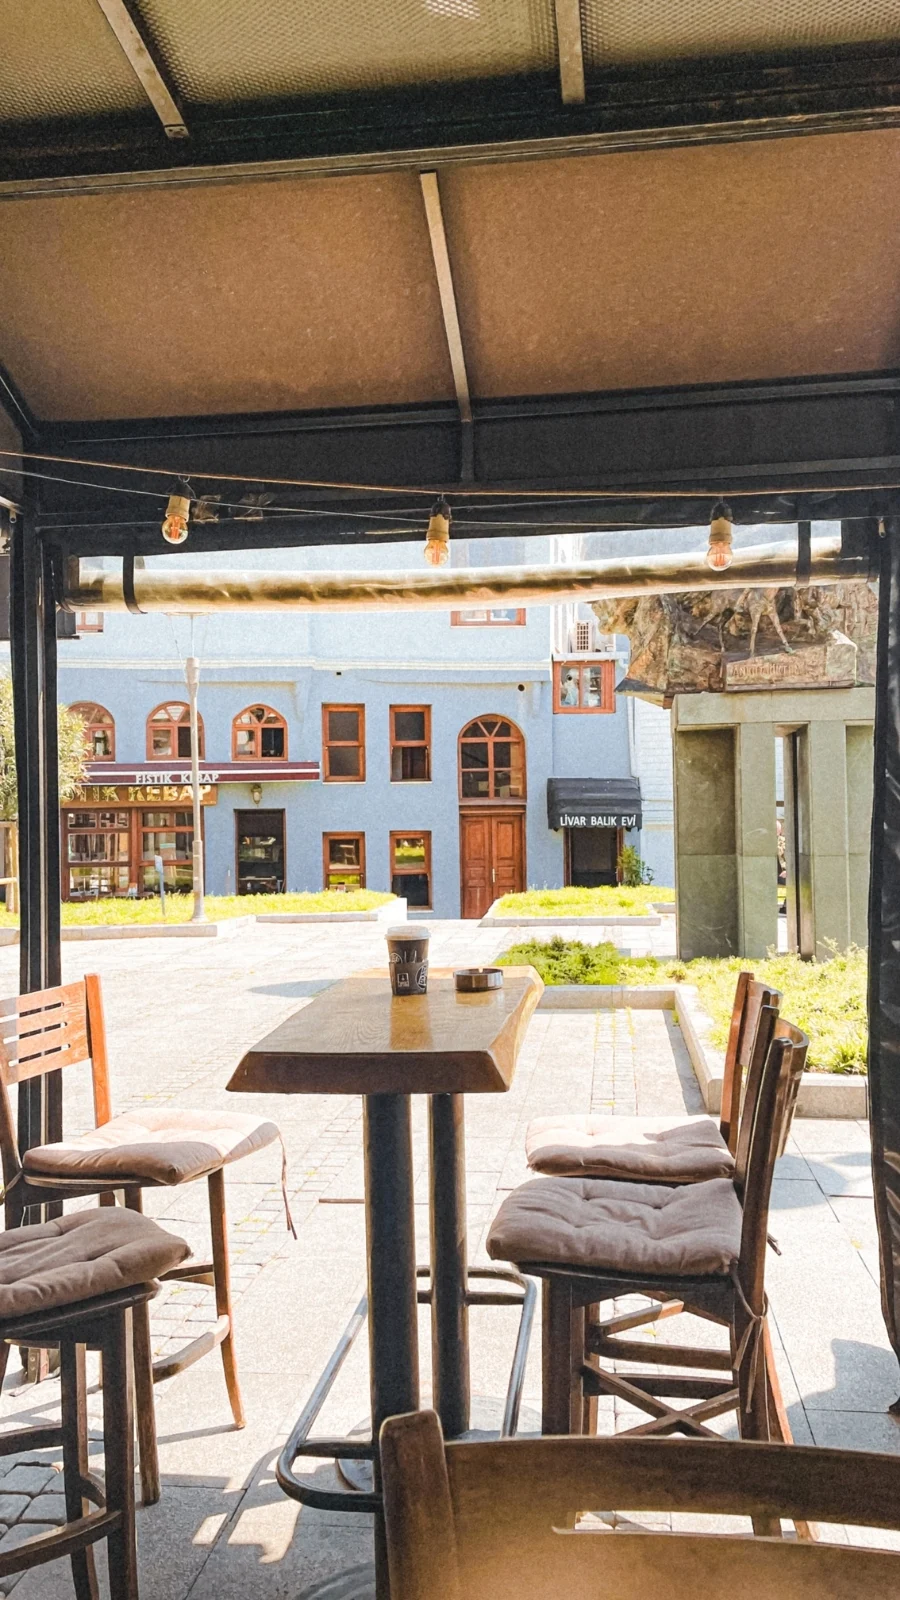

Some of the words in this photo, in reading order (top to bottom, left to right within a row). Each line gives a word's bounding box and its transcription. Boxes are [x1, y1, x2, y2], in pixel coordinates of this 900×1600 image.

[135, 774, 172, 784] FISTIK
[127, 785, 211, 802] KEBAP
[560, 814, 586, 826] LİVAR
[590, 816, 617, 826] BALIK
[621, 815, 636, 826] EVİ
